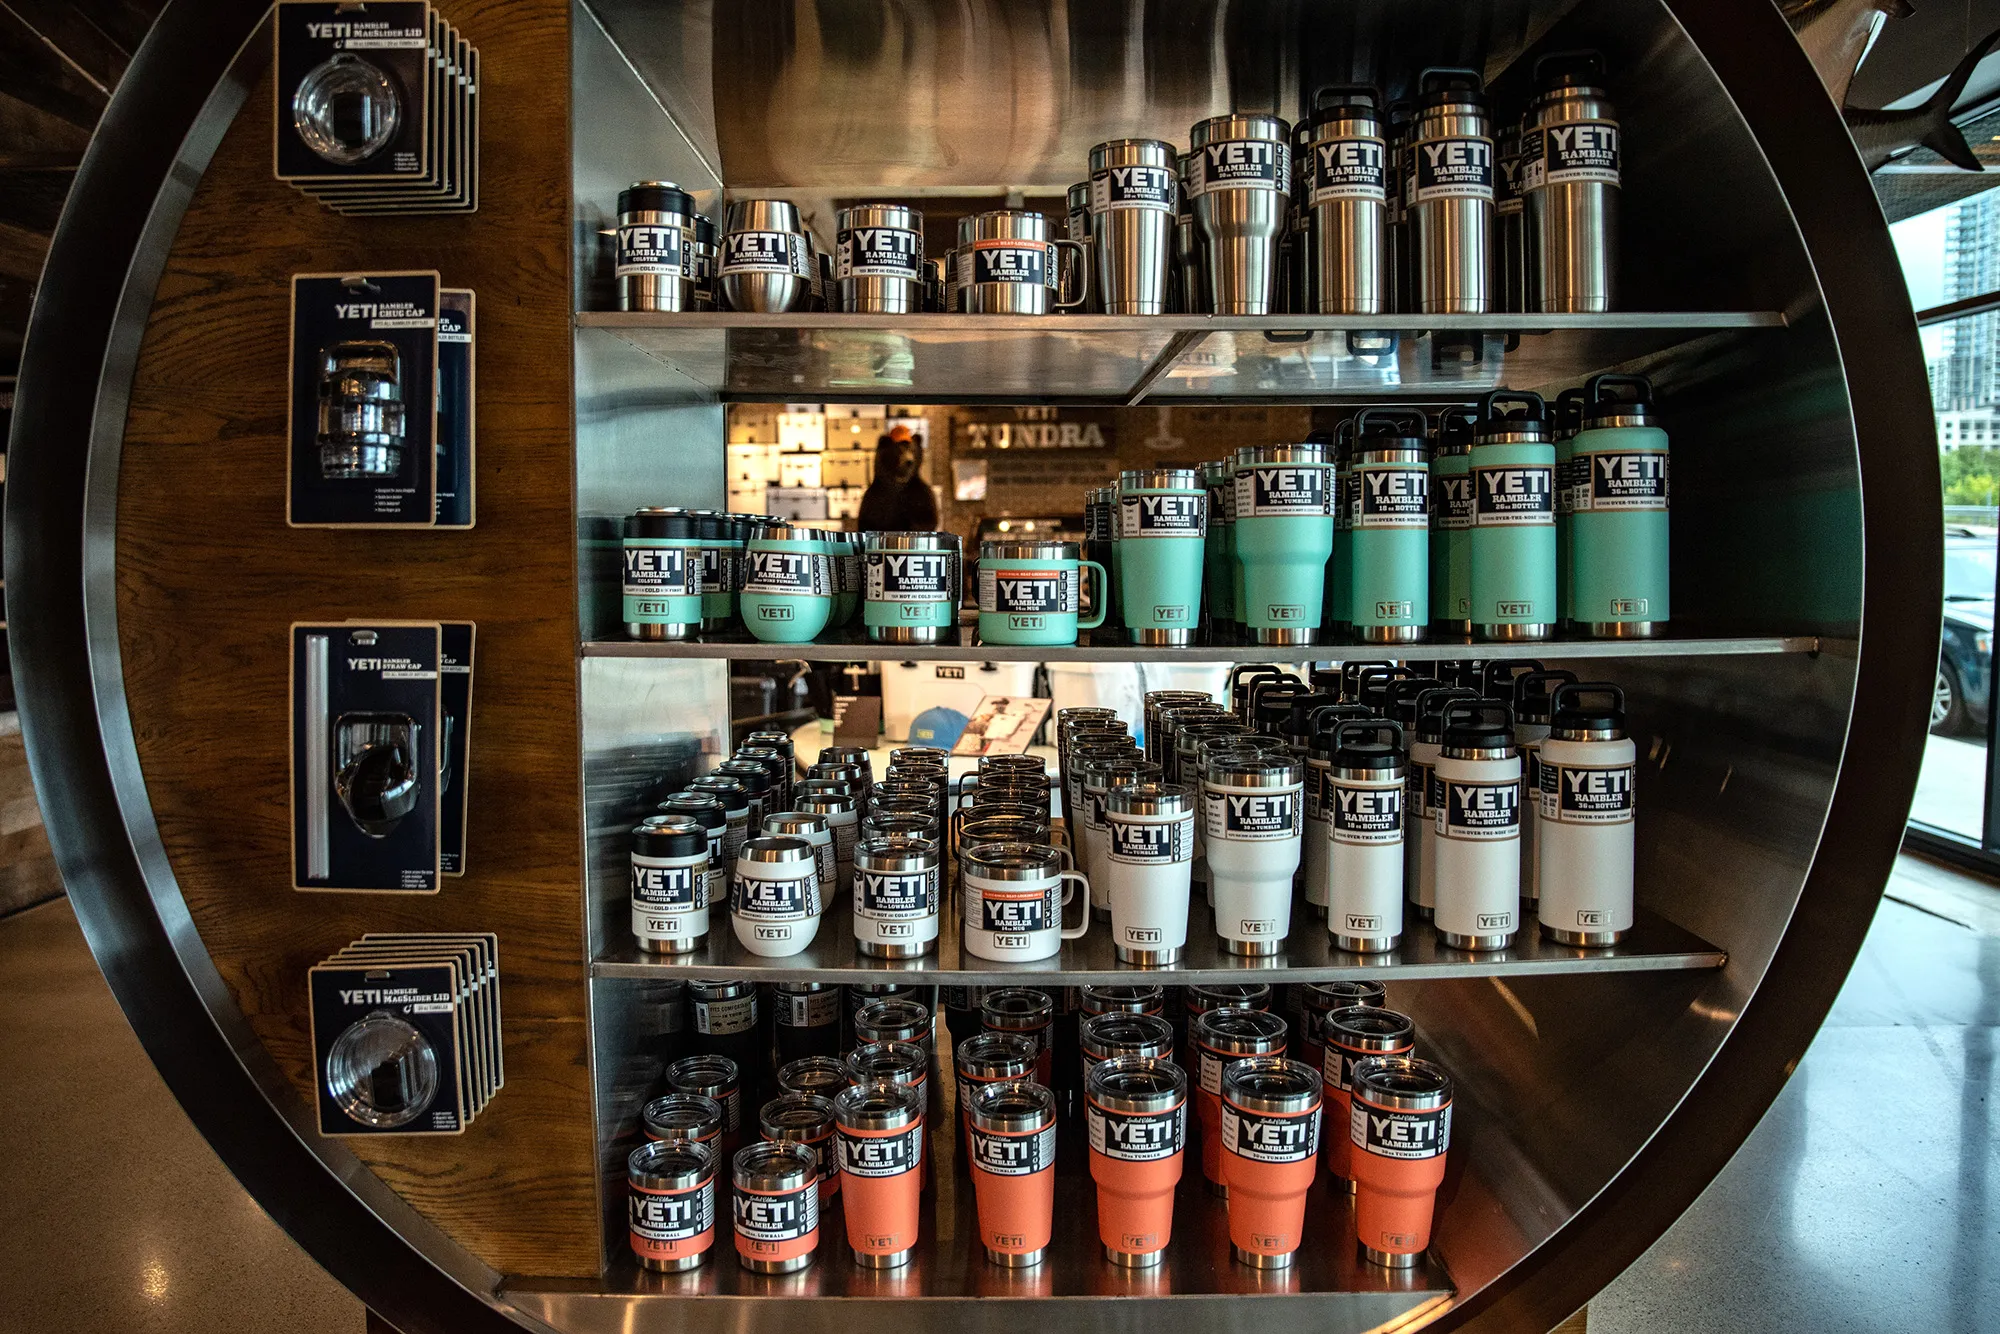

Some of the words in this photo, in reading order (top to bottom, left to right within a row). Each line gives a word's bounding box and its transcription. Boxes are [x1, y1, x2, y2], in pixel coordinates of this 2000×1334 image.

[307, 23, 351, 38] YETI
[404, 28, 422, 37] LID
[1551, 126, 1617, 151] YETI
[1207, 142, 1272, 166] YETI
[1318, 143, 1383, 169] YETI
[1424, 142, 1490, 168] YETI
[1561, 150, 1614, 160] RAMBLER
[1218, 164, 1262, 172] RAMBLER
[1327, 166, 1380, 177] RAMBLER
[1434, 166, 1483, 176] RAMBLER
[1112, 168, 1168, 190] YETI
[620, 228, 678, 250] YETI
[729, 233, 786, 253] YETI
[855, 230, 916, 255] YETI
[626, 249, 668, 257] RAMBLER
[865, 252, 908, 260] RAMBLER
[982, 250, 1040, 270] YETI
[335, 304, 377, 319] YETI
[380, 310, 404, 318] CHUG
[406, 309, 425, 317] CAP
[442, 324, 461, 332] CAP
[968, 423, 1105, 448] TUNDRA
[1598, 457, 1664, 479] YETI
[1258, 470, 1322, 491] YETI
[1366, 473, 1427, 495] YETI
[1483, 471, 1549, 494] YETI
[1608, 479, 1657, 488] RAMBLER
[1443, 480, 1470, 500] YE
[1376, 496, 1423, 504] RAMBLER
[1492, 494, 1541, 503] RAMBLER
[1142, 497, 1198, 516] YETI
[625, 551, 682, 571] YETI
[753, 553, 809, 574] YETI
[886, 556, 946, 576] YETI
[758, 572, 797, 580] RAMBLER
[1000, 581, 1056, 600] YETI
[637, 603, 665, 612] YETI
[1380, 605, 1411, 616] YETI
[1501, 605, 1531, 614] YETI
[1614, 602, 1644, 612] YETI
[761, 608, 791, 618] YETI
[1271, 608, 1302, 618] YETI
[1012, 618, 1042, 627] YETI
[348, 658, 381, 671] YETI
[938, 668, 963, 678] YETI
[1565, 770, 1630, 793] YETI
[1337, 789, 1400, 814] YETI
[1454, 785, 1517, 809] YETI
[1575, 794, 1623, 802] RAMBLER
[1229, 795, 1292, 817] YETI
[1345, 813, 1394, 822] RAMBLER
[1464, 809, 1511, 818] RAMBLER
[1240, 817, 1282, 825] RAMBLER
[1114, 823, 1169, 844] YETI
[1122, 843, 1159, 851] RAMBLER
[634, 867, 690, 889] YETI
[745, 879, 801, 900] YETI
[866, 874, 926, 896] YETI
[640, 888, 679, 897] RAMBLER
[986, 901, 1041, 920] YETI
[649, 920, 677, 930] YETI
[1350, 918, 1379, 928] YETI
[1480, 916, 1508, 927] YETI
[880, 925, 910, 934] YETI
[1244, 923, 1274, 932] YETI
[758, 929, 788, 938] YETI
[1128, 930, 1158, 941] YETI
[996, 936, 1026, 946] YETI
[340, 989, 381, 1005] YETI
[433, 993, 450, 1002] LID
[1109, 1120, 1172, 1143] YETI
[1242, 1119, 1306, 1144] YETI
[1371, 1115, 1436, 1141] YETI
[975, 1135, 1028, 1160] YETI
[1253, 1143, 1295, 1152] RAMBLER
[1382, 1140, 1424, 1149] RAMBLER
[848, 1140, 904, 1161] YETI
[983, 1156, 1017, 1166] RAMBLER
[634, 1197, 691, 1222] YETI
[738, 1196, 794, 1222] YETI
[642, 1219, 680, 1228] RAMBLER
[746, 1220, 784, 1229] RAMBLER
[648, 1241, 672, 1250] YETI
[752, 1242, 775, 1250] YETI
[869, 1237, 898, 1246] YETI
[994, 1235, 1023, 1246] YETI
[1126, 1236, 1156, 1246] YETI
[1255, 1236, 1285, 1247] YETI
[1385, 1235, 1416, 1246] YETI
